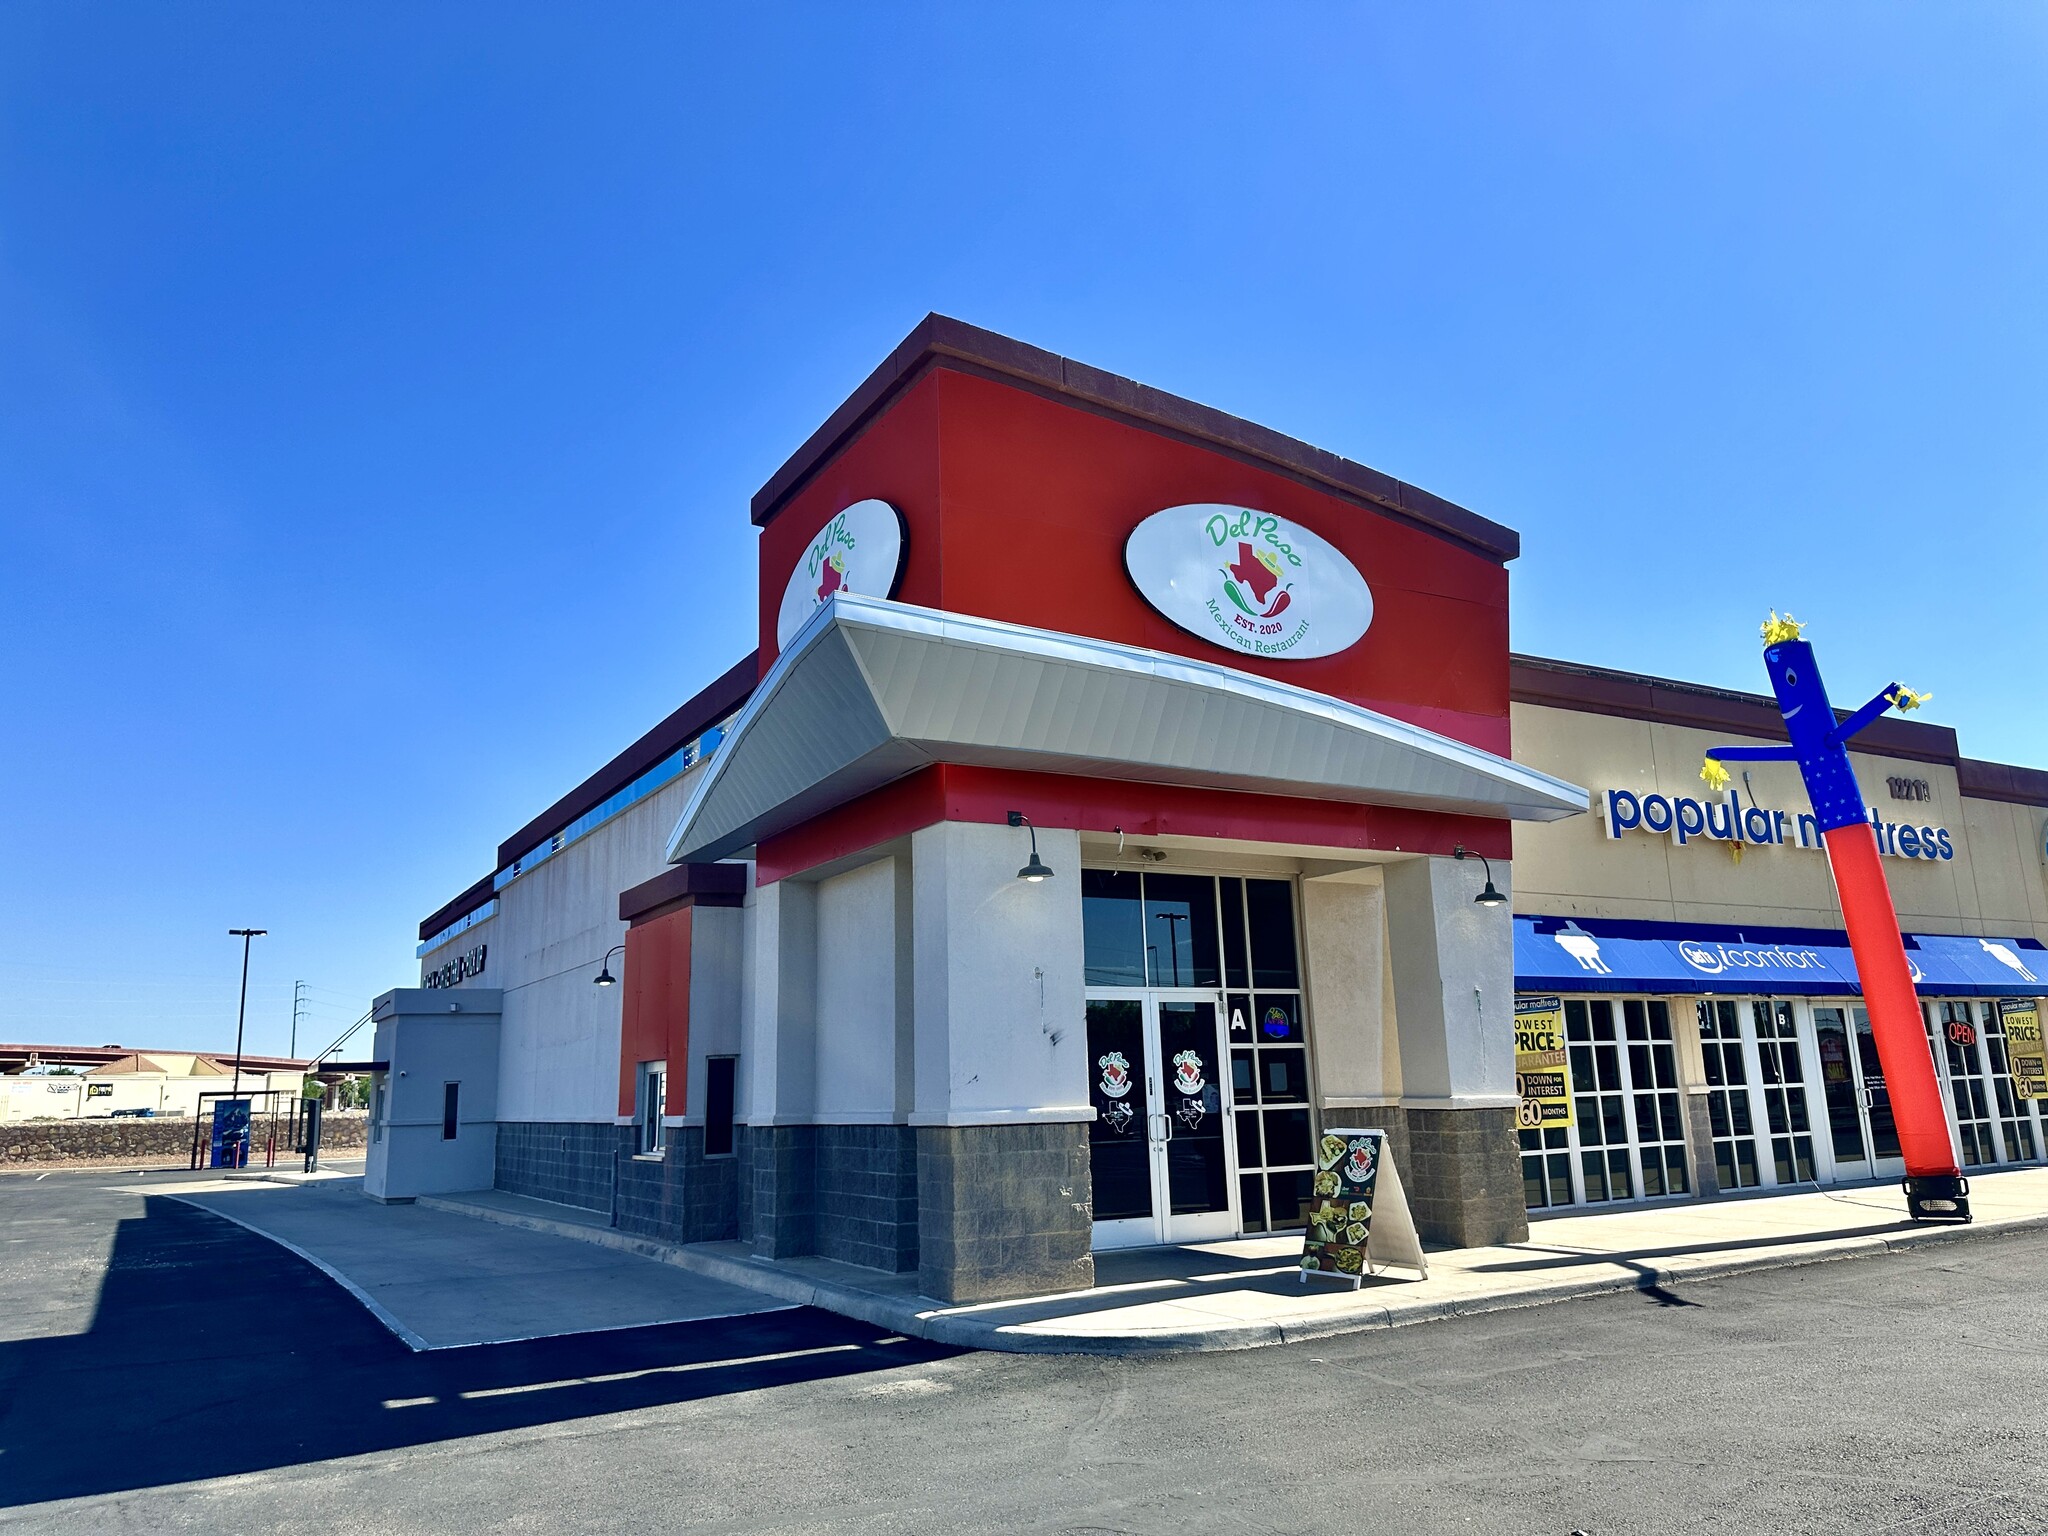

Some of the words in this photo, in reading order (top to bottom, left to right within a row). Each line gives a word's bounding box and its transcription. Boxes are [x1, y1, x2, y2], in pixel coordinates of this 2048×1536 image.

[807, 523, 832, 578] Del
[831, 513, 856, 550] Paso
[1205, 510, 1251, 547] Del
[1252, 516, 1302, 567] Paso
[1205, 598, 1252, 650] Mexican
[1254, 619, 1310, 654] Restaurant
[1233, 614, 1258, 634] EST.
[1259, 622, 1283, 635] 2020
[1603, 789, 1785, 846] popular
[1791, 807, 1954, 861] mtress
[1717, 944, 1826, 969] icomfort
[1514, 1000, 1528, 1010] ular
[1529, 999, 1559, 1009] mattress
[1230, 1008, 1247, 1030] A
[1514, 1019, 1553, 1030] OWEST
[1778, 1013, 1786, 1025] B
[2005, 1016, 2034, 1025] LOWEST
[1948, 1022, 1976, 1045] OPEN
[2008, 1026, 2036, 1041] PRICE
[1517, 1051, 1566, 1068] ARANTEE
[2013, 1057, 2022, 1077] 0
[1527, 1075, 1553, 1085] DOWN
[1528, 1085, 1563, 1096] INTEREST
[2019, 1077, 2033, 1098] 60
[1519, 1098, 1543, 1126] 60
[1542, 1107, 1567, 1116] MONTHS
